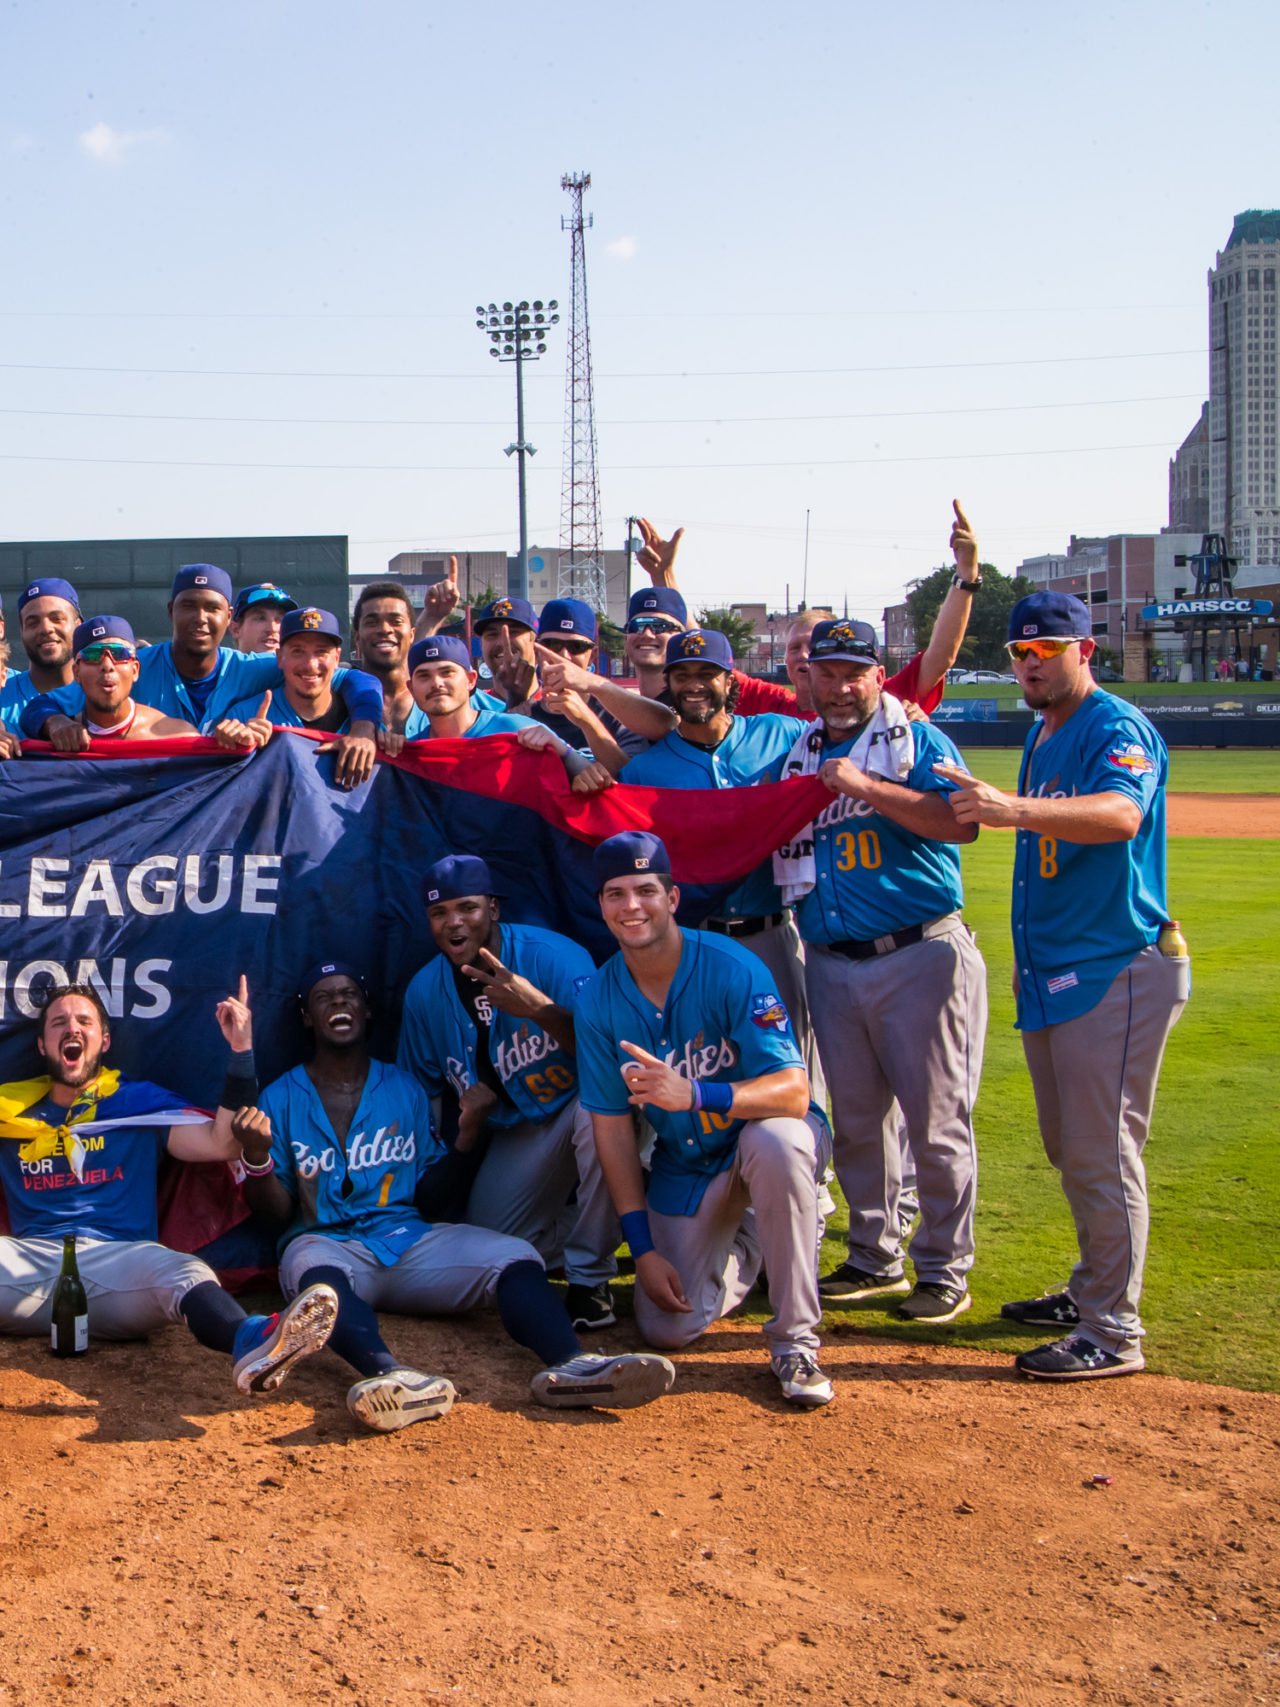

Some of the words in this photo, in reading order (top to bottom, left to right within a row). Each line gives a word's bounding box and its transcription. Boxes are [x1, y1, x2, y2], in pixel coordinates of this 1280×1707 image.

[836, 830, 882, 871] 30
[1038, 834, 1058, 878] 8
[524, 1064, 575, 1103] 50
[21, 1158, 53, 1175] FOR
[23, 1166, 124, 1191] VENEZUELA
[376, 1173, 395, 1207] 1
